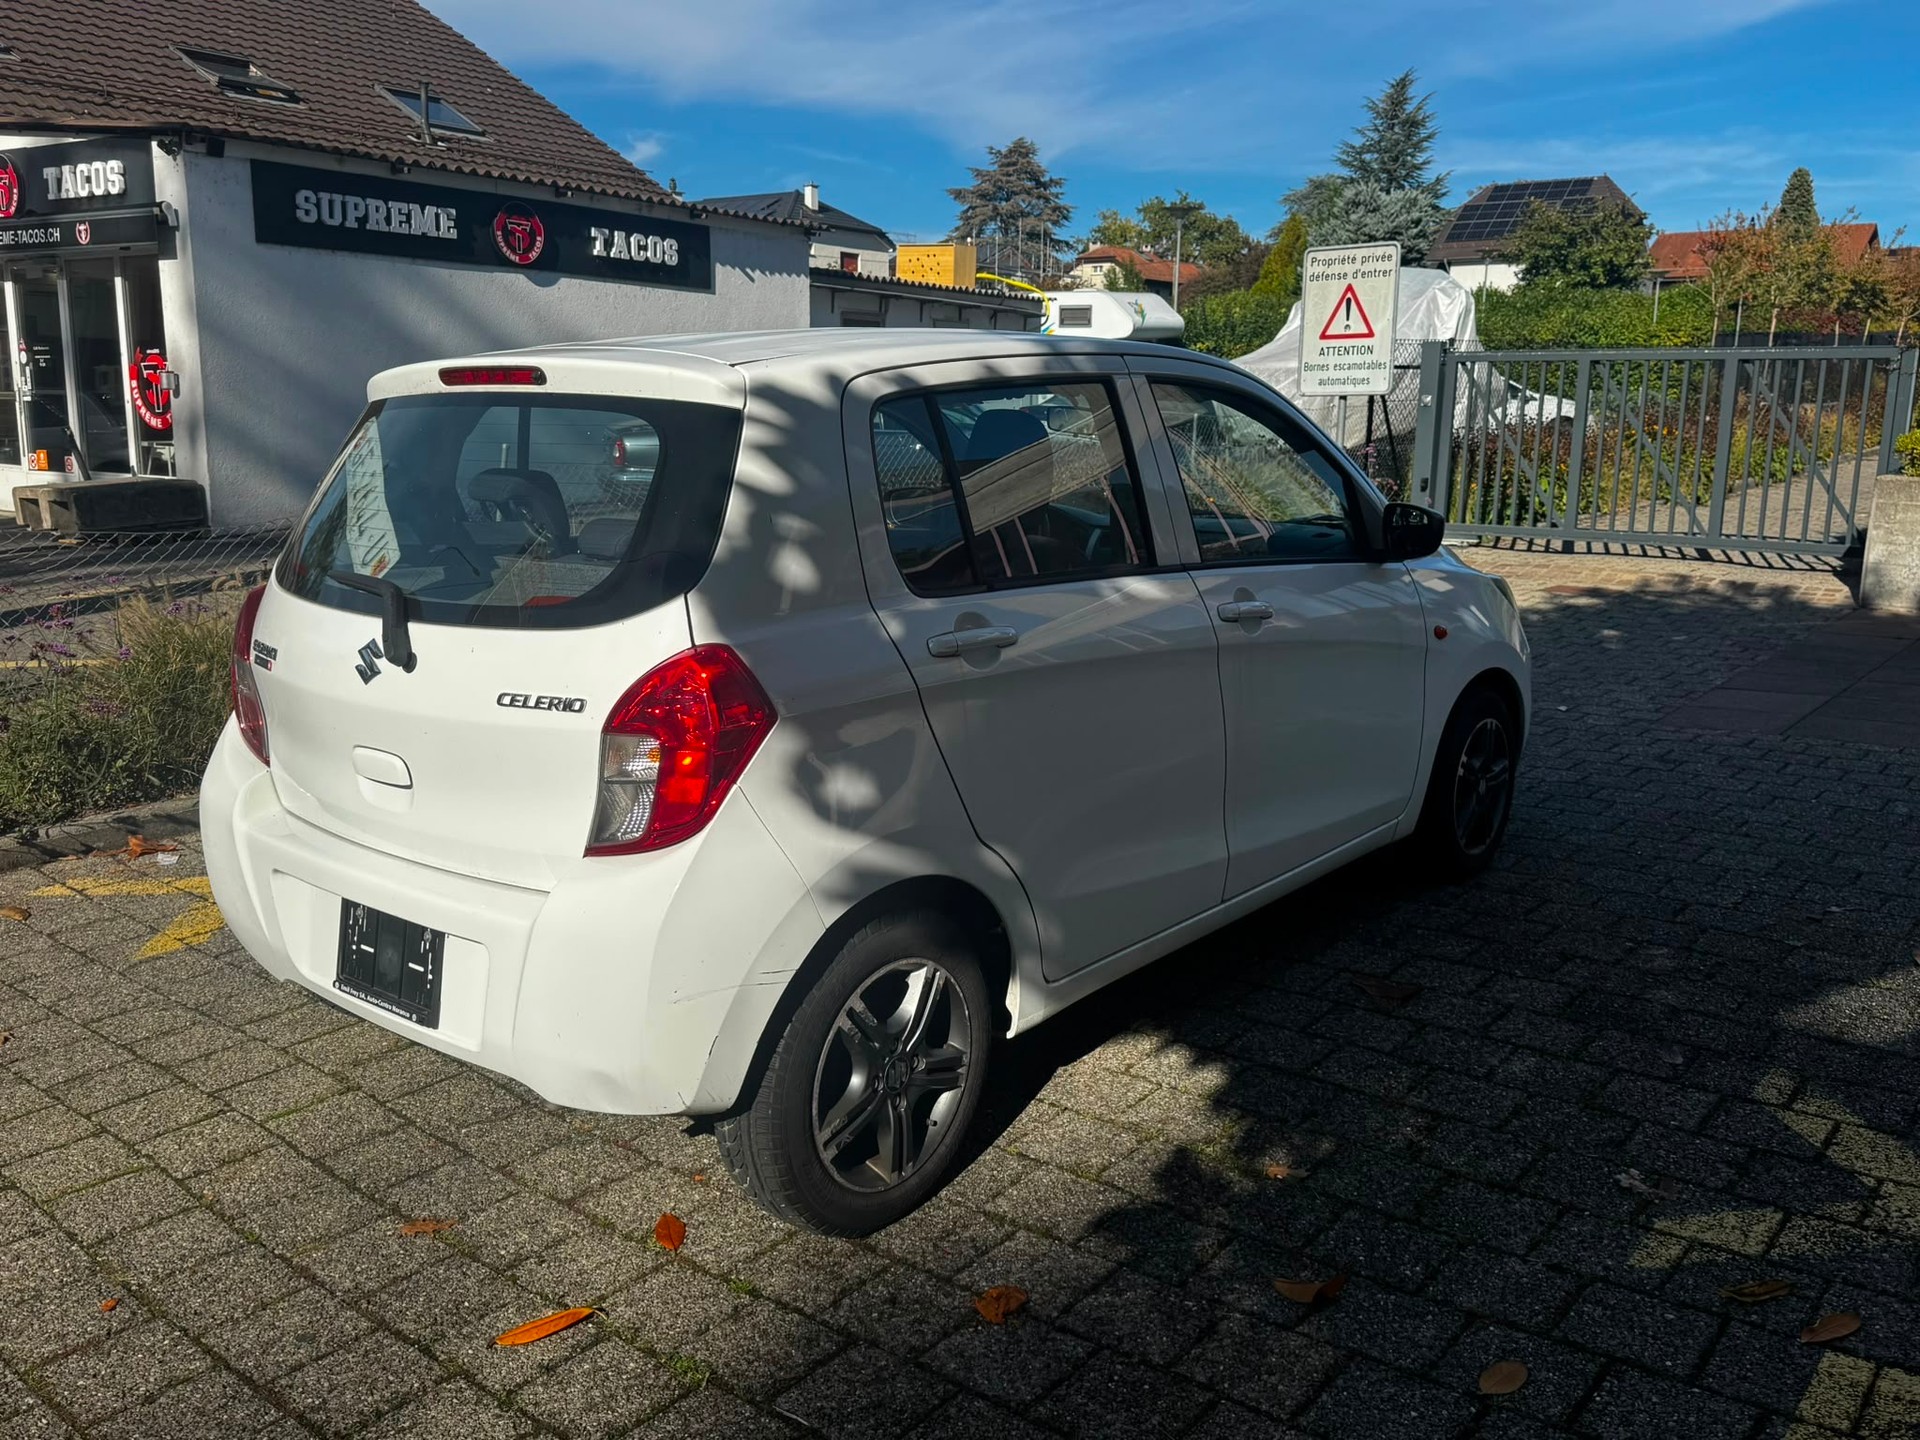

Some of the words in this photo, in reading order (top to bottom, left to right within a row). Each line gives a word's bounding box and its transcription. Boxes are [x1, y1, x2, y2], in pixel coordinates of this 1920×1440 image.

[43, 160, 125, 200] TACOS
[295, 189, 457, 239] SUPREME
[529, 236, 542, 260] TACOS
[591, 226, 679, 266] TACOS
[1310, 254, 1357, 269] Propriété
[1360, 252, 1393, 266] privée
[1309, 271, 1348, 282] défense
[1352, 268, 1393, 280] d'entrer
[1318, 345, 1374, 357] ATTENTION
[1303, 362, 1330, 372] Bornes
[1333, 359, 1387, 371] escamotables
[1317, 376, 1370, 387] automatiques
[131, 380, 162, 428] SUPREME
[496, 692, 588, 714] CELERIO
